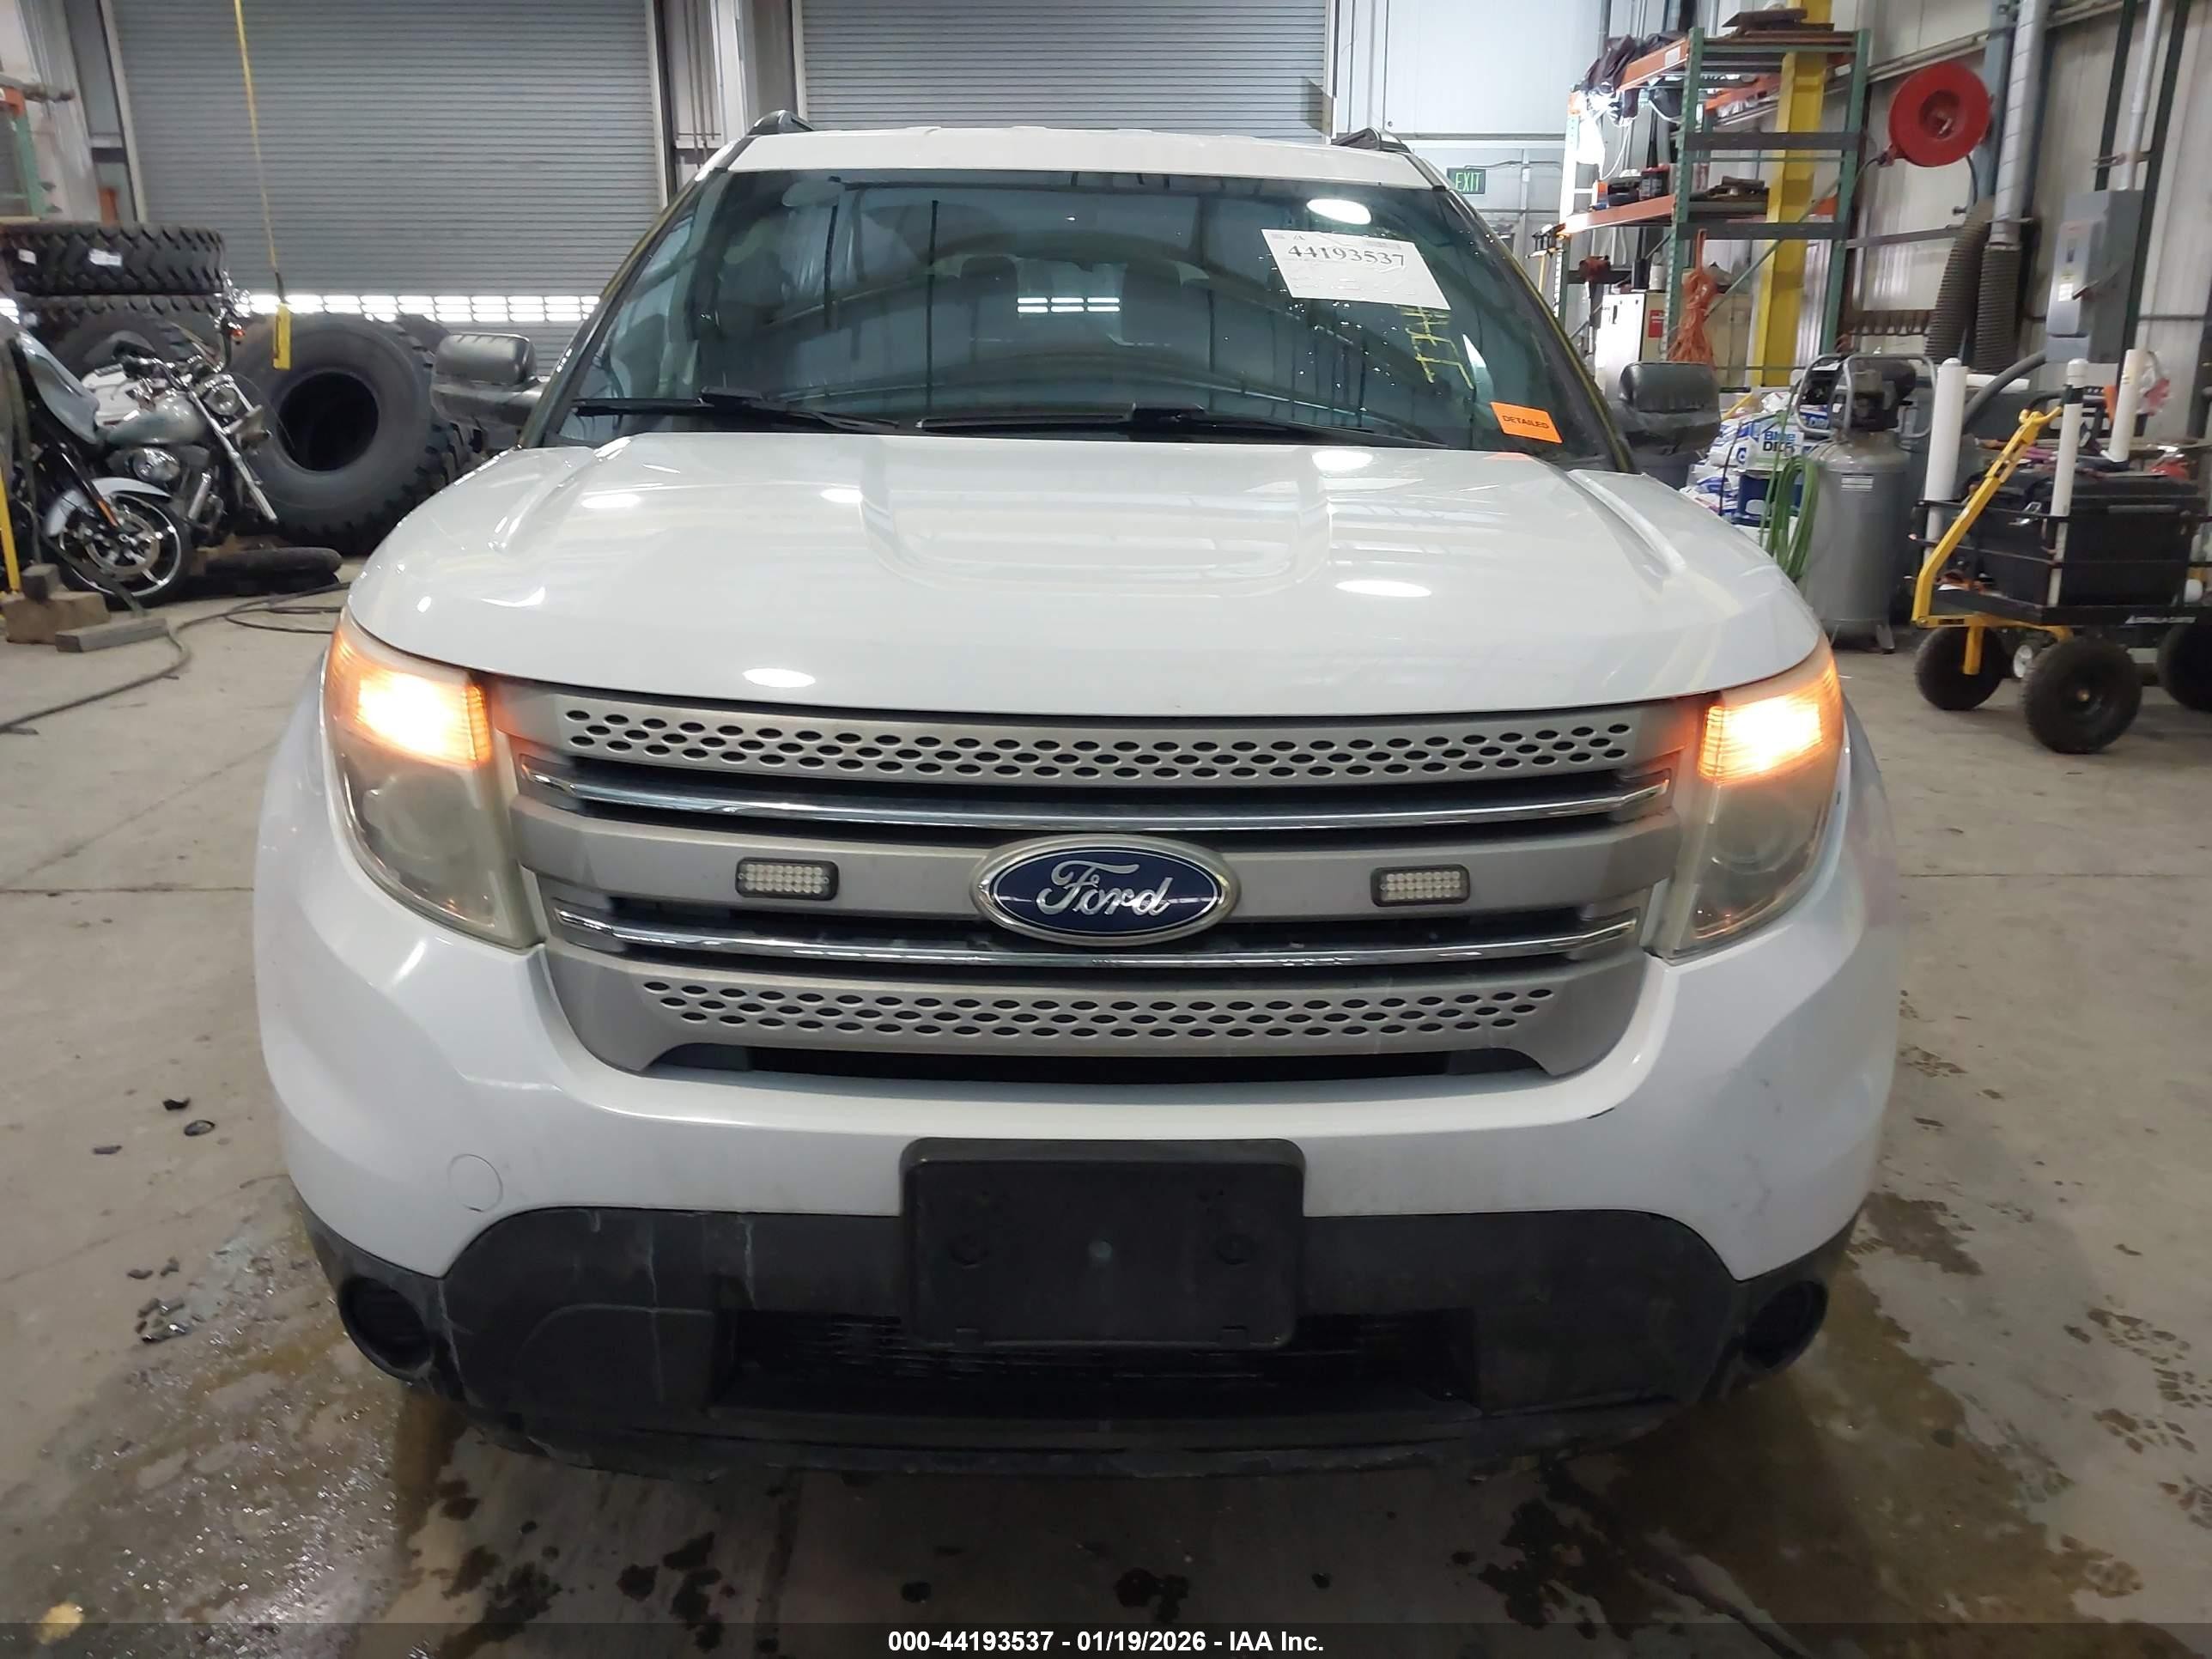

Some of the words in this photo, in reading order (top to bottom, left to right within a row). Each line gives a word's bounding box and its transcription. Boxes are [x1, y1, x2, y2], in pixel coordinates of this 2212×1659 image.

[1455, 172, 1482, 192] EXIT
[1287, 244, 1405, 267] 44193537
[1501, 415, 1550, 429] DETAILED
[1036, 860, 1174, 916] Ford
